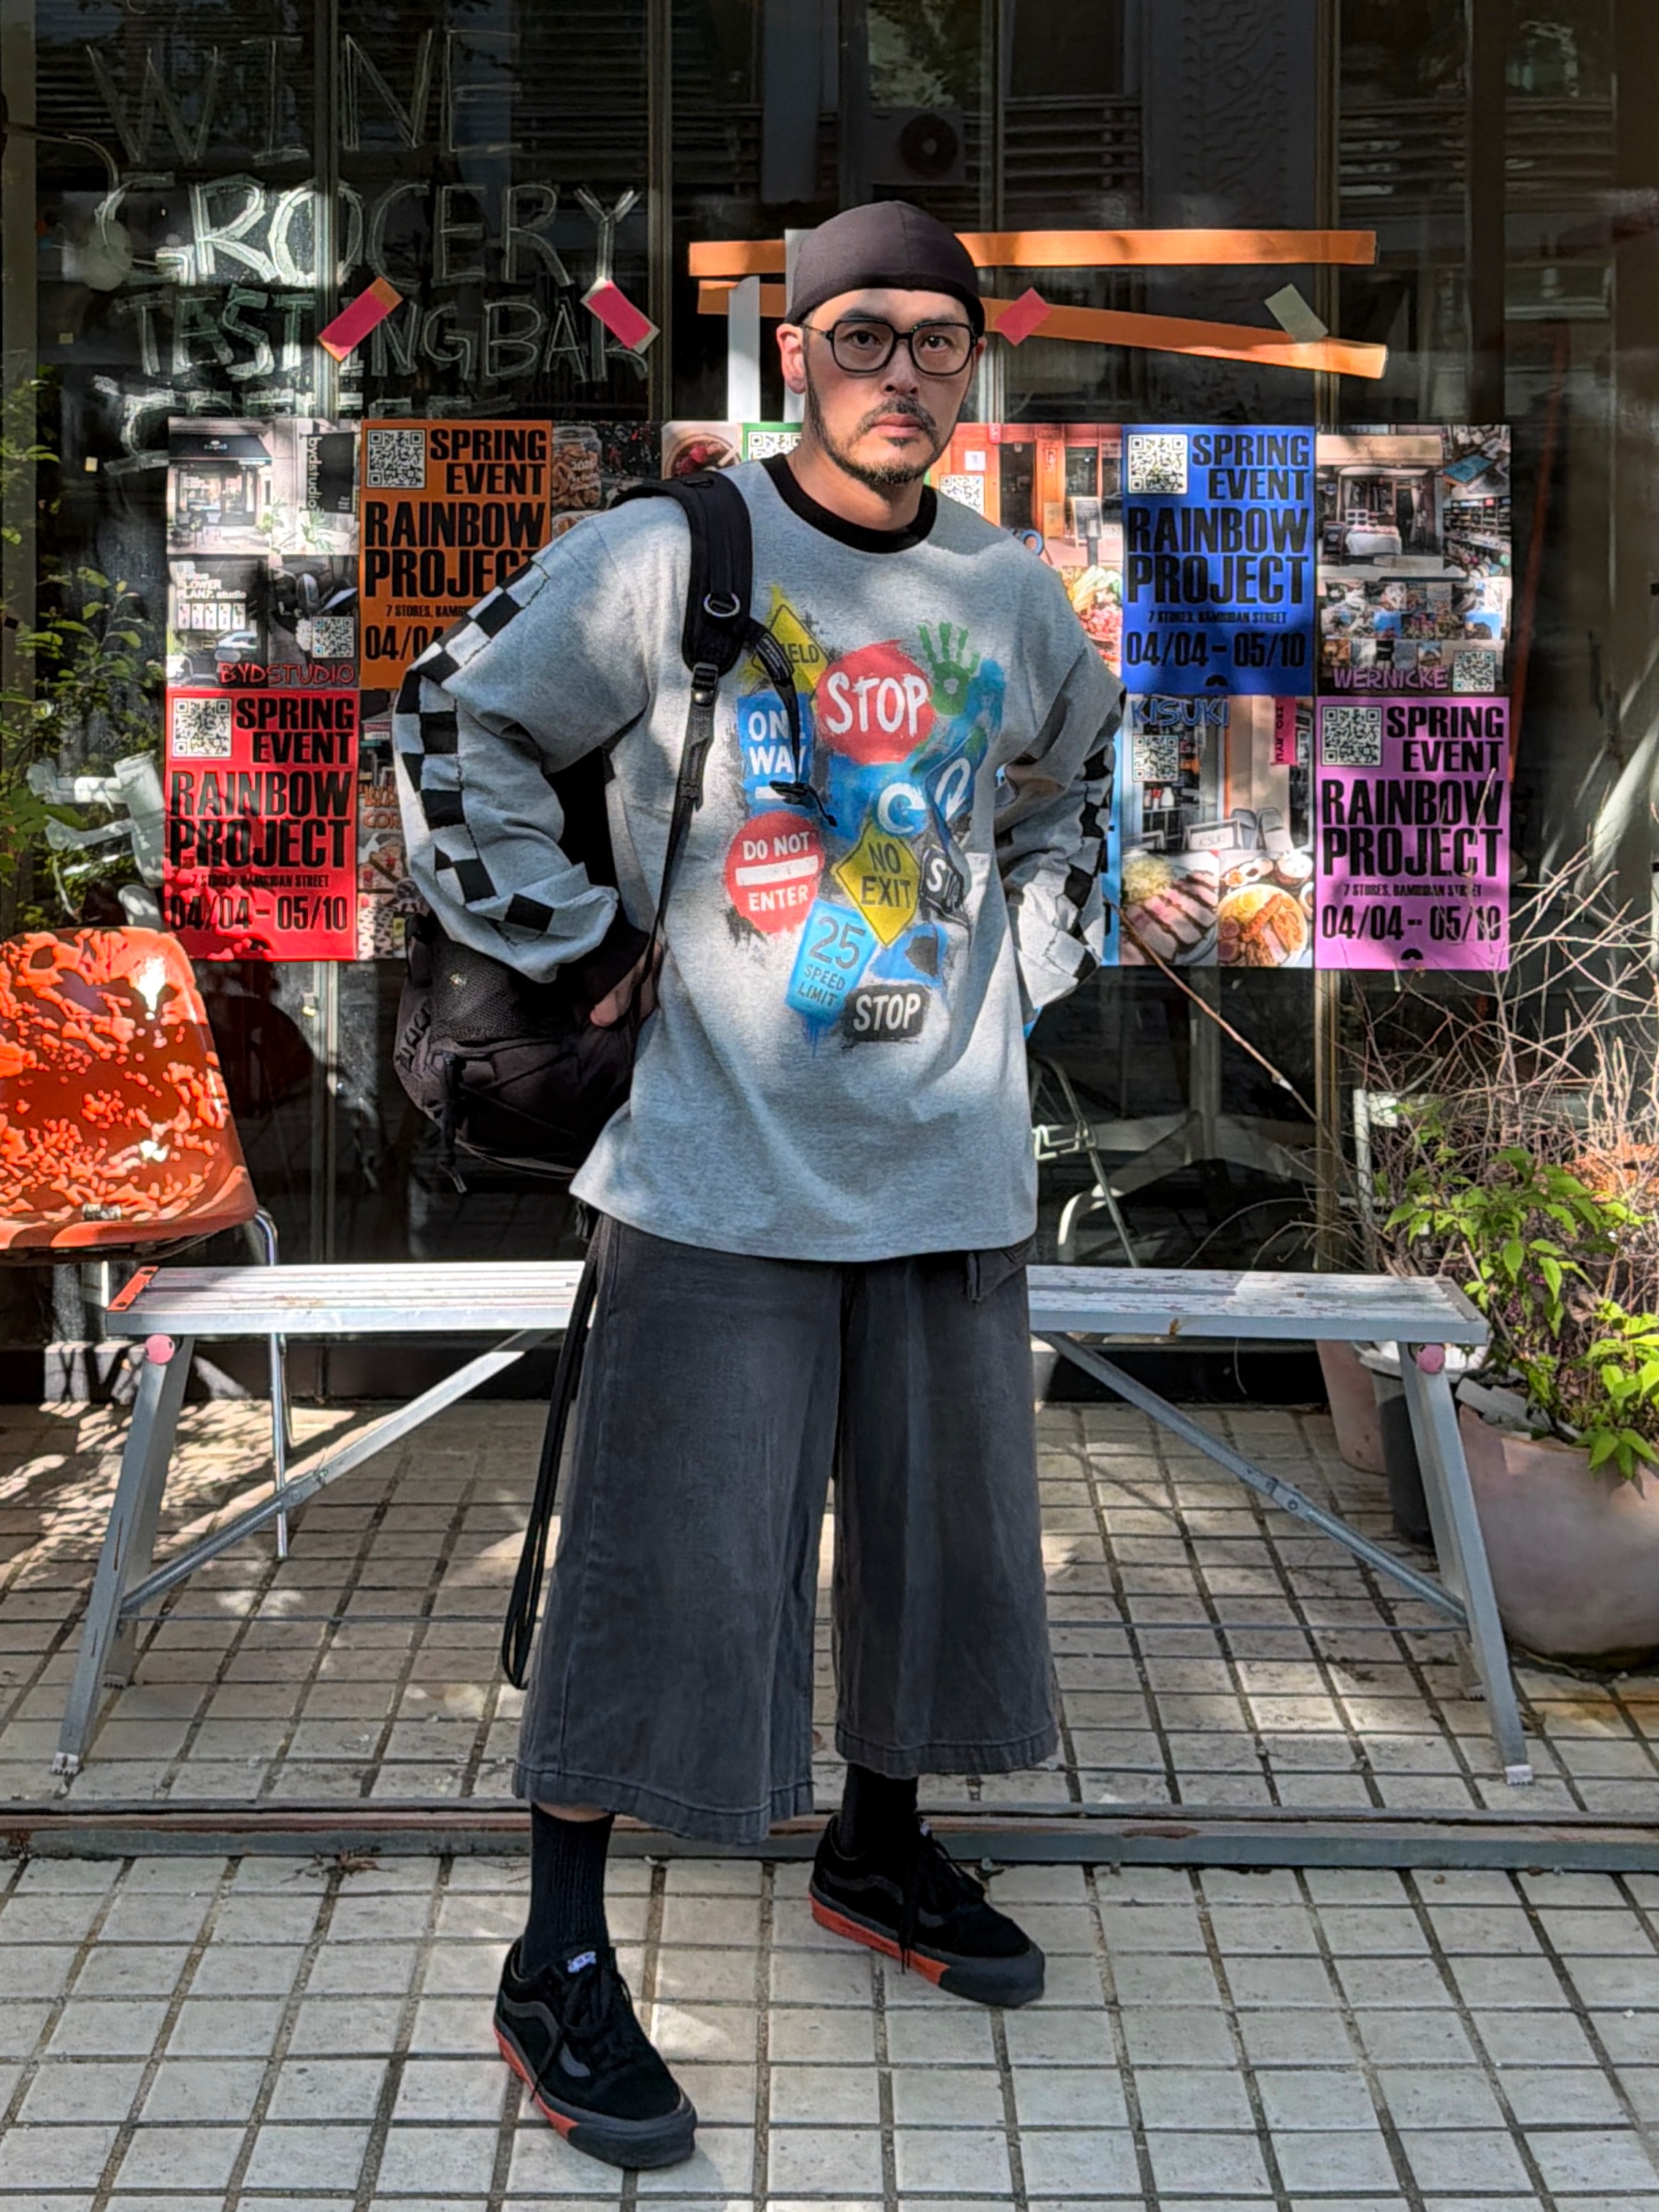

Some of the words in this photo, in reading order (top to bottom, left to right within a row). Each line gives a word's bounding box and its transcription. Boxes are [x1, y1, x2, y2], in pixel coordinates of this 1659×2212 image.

[86, 29, 523, 165] WINE
[95, 172, 644, 289] GROCERY
[430, 429, 547, 462] SPRING
[1192, 434, 1310, 467] SPRING
[307, 436, 323, 509] bydstudio
[445, 462, 546, 496] EVENT
[1208, 468, 1306, 501] EVENT
[365, 501, 546, 548] RAINBOW
[1127, 507, 1308, 554] RAINBOW
[1127, 555, 1309, 605] PROJECT
[386, 605, 392, 616] 7
[1252, 612, 1287, 624] STREET
[1234, 632, 1306, 667] 05/10
[219, 661, 355, 685] BYDSTUDIO
[1333, 666, 1449, 691] WERNICKE
[236, 697, 355, 730] SPRING
[825, 671, 930, 738] STOP
[1131, 697, 1230, 728] KISUKI
[748, 710, 806, 742] ON
[1387, 706, 1504, 738] SPRING
[253, 731, 353, 764] EVENT
[1403, 740, 1503, 773] EVENT
[171, 770, 352, 817] RAINBOW
[1321, 779, 1503, 826] RAINBOW
[169, 818, 351, 868] PROJECT
[743, 839, 768, 861] DO
[773, 830, 811, 857] NOT
[870, 841, 903, 873] NO
[1322, 827, 1503, 877] PROJECT
[295, 875, 330, 888] STREET
[748, 884, 808, 912] ENTER
[860, 876, 912, 908] EXIT
[1344, 884, 1349, 896] 7
[277, 895, 348, 930] 05/10
[1430, 905, 1501, 941] 05/10
[808, 915, 867, 970] 25
[804, 963, 846, 991] SPEED
[797, 981, 839, 1007] LIMIT
[853, 992, 922, 1032] STOP
